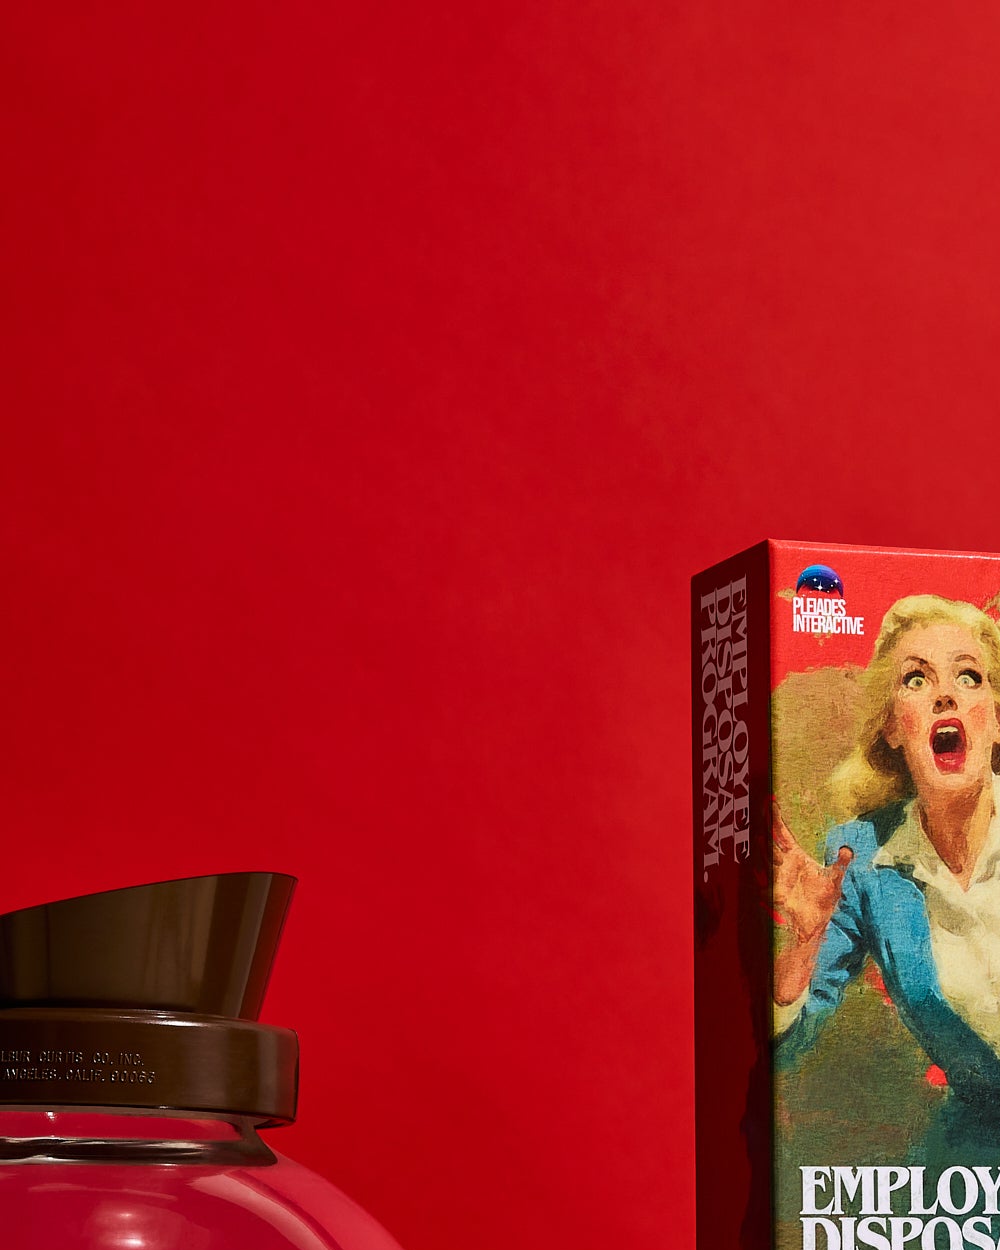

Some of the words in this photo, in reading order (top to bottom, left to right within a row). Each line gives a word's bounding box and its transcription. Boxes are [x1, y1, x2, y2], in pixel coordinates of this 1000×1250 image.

[792, 597, 846, 617] PLEIADES
[793, 615, 865, 636] INTERACTIVE
[701, 594, 720, 884] PROGRAM.
[715, 587, 735, 856] DISPOSAL
[731, 573, 750, 864] EMPLOYEE
[39, 1050, 83, 1064] CURTIS
[119, 1052, 145, 1067] INC.
